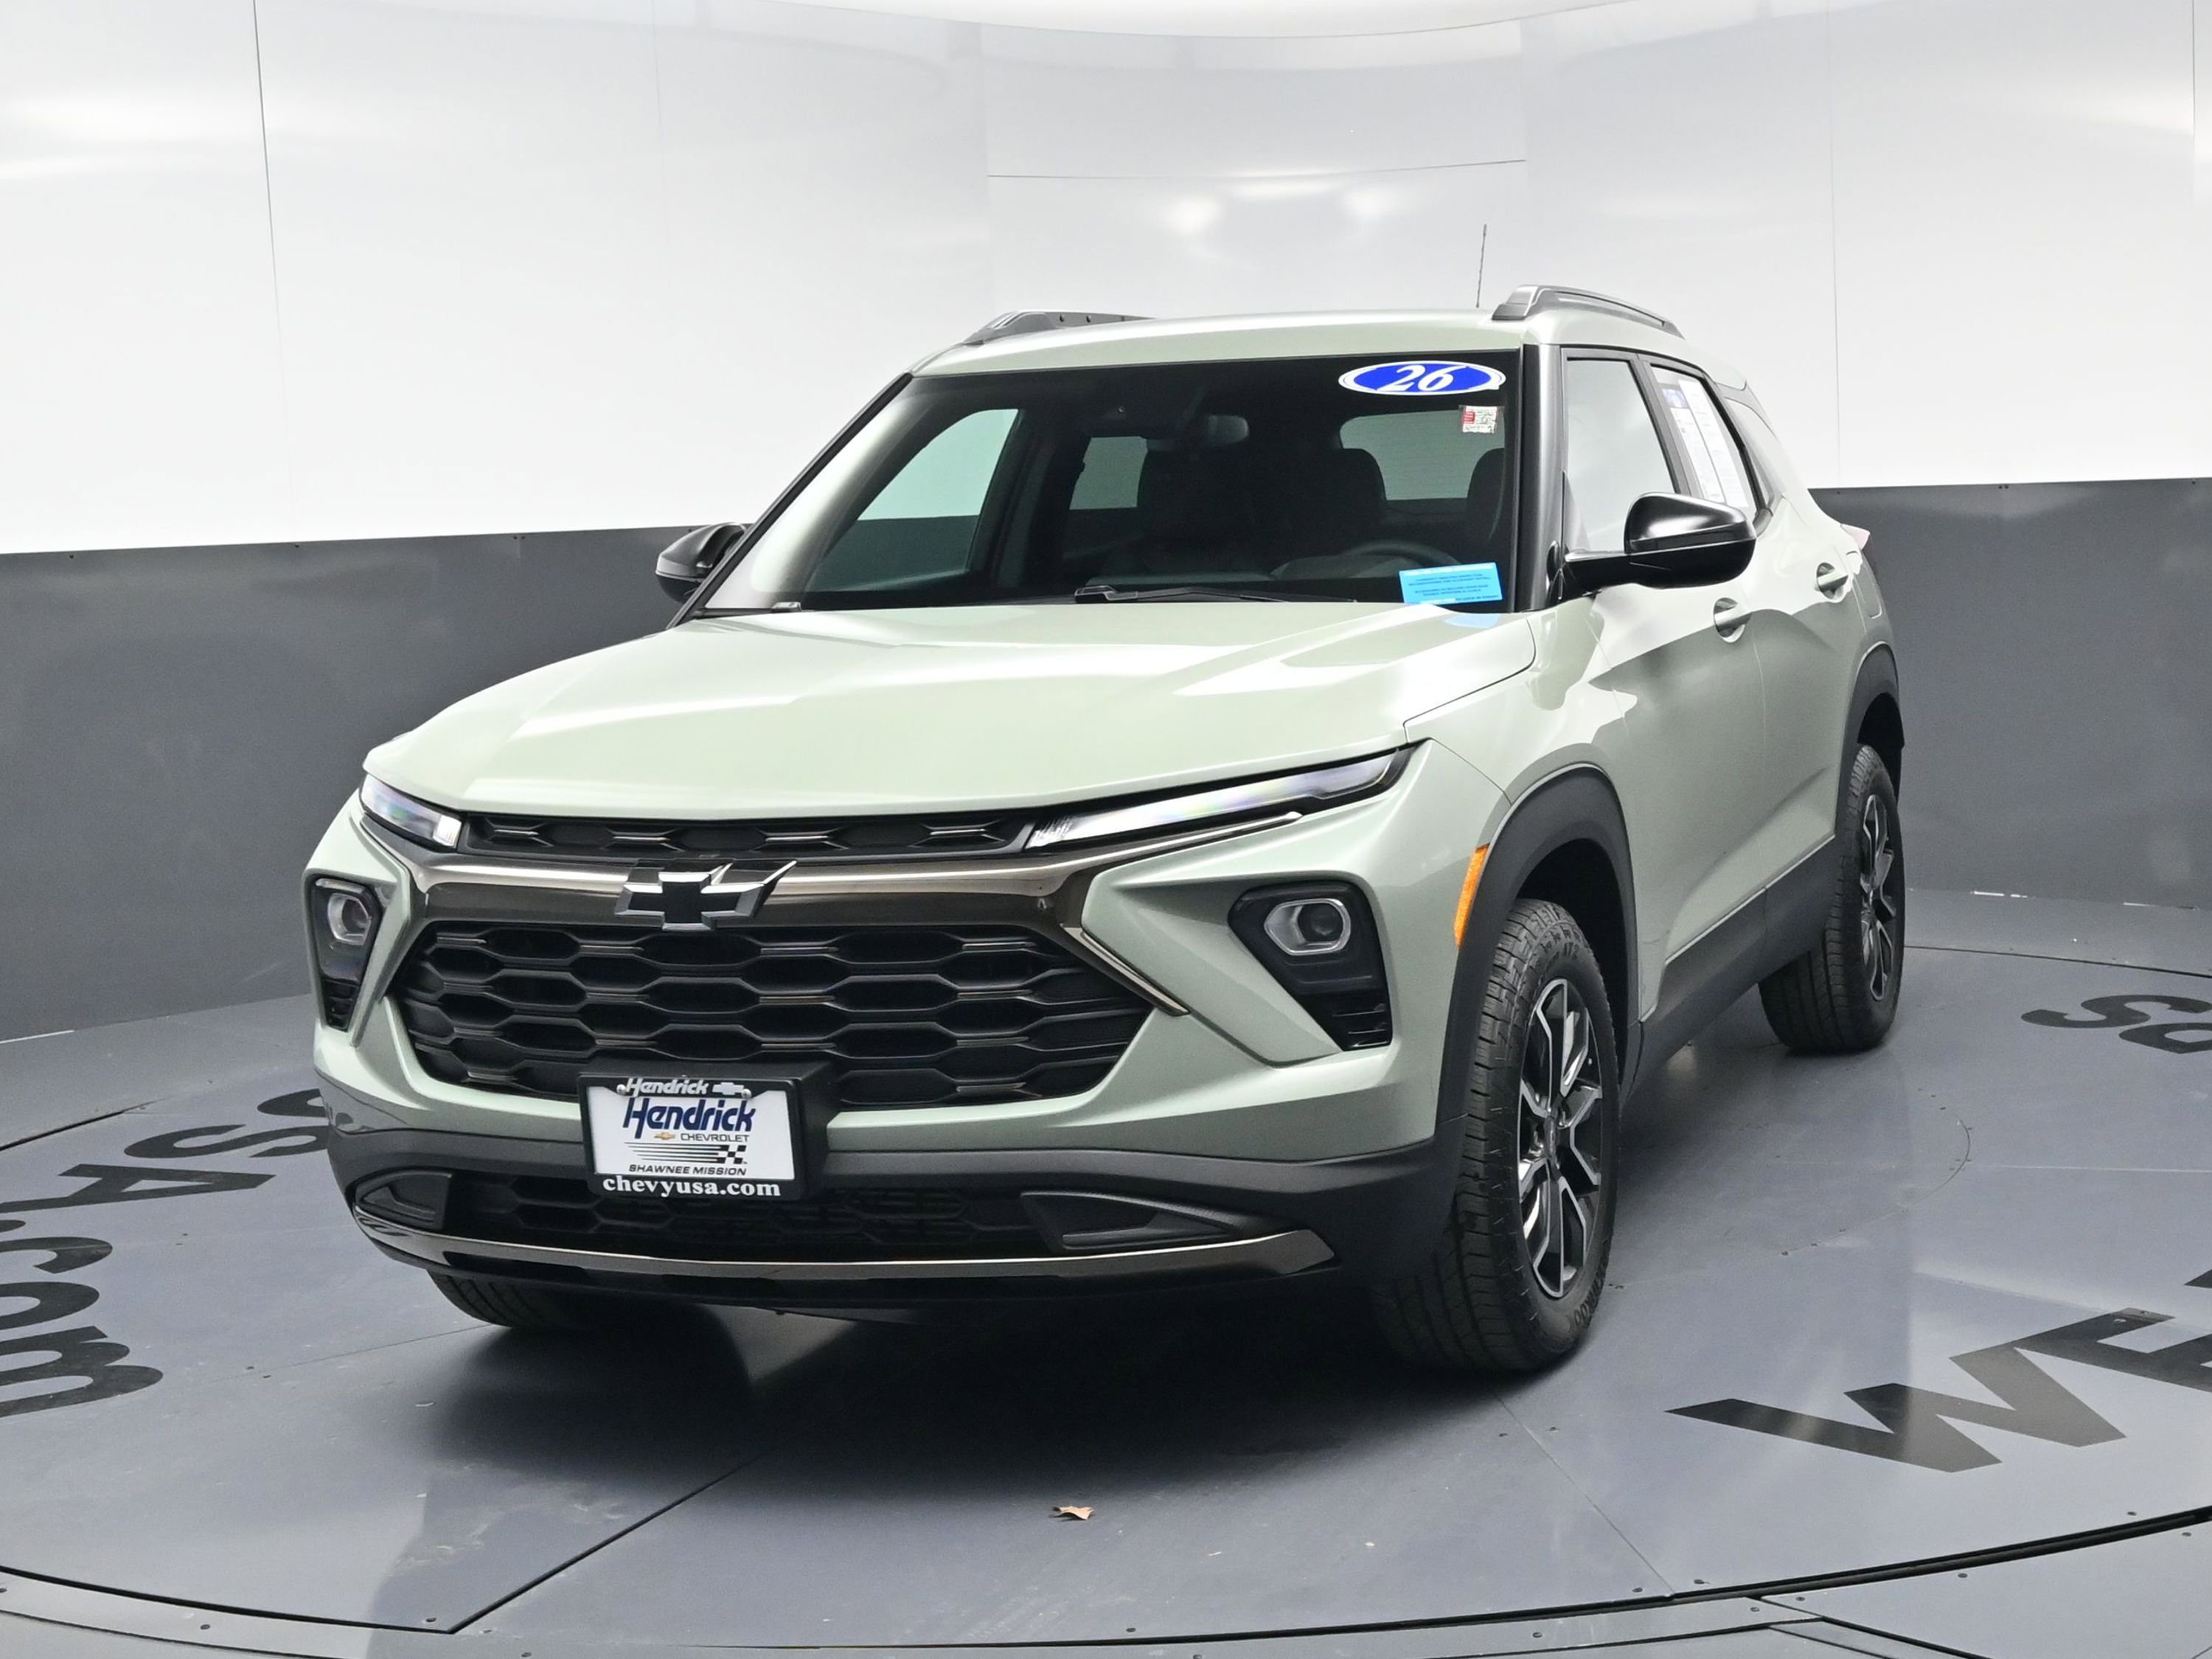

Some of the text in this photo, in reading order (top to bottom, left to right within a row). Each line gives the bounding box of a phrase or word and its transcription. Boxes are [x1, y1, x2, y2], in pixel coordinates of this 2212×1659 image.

[1377, 364, 1468, 392] 26
[627, 1078, 709, 1097] Hendrick
[623, 1097, 756, 1139] Hendrick
[680, 1133, 750, 1142] CHEVROLET
[629, 1164, 747, 1176] SHAWNEE MISSION
[602, 1175, 781, 1197] chevyusa.com
